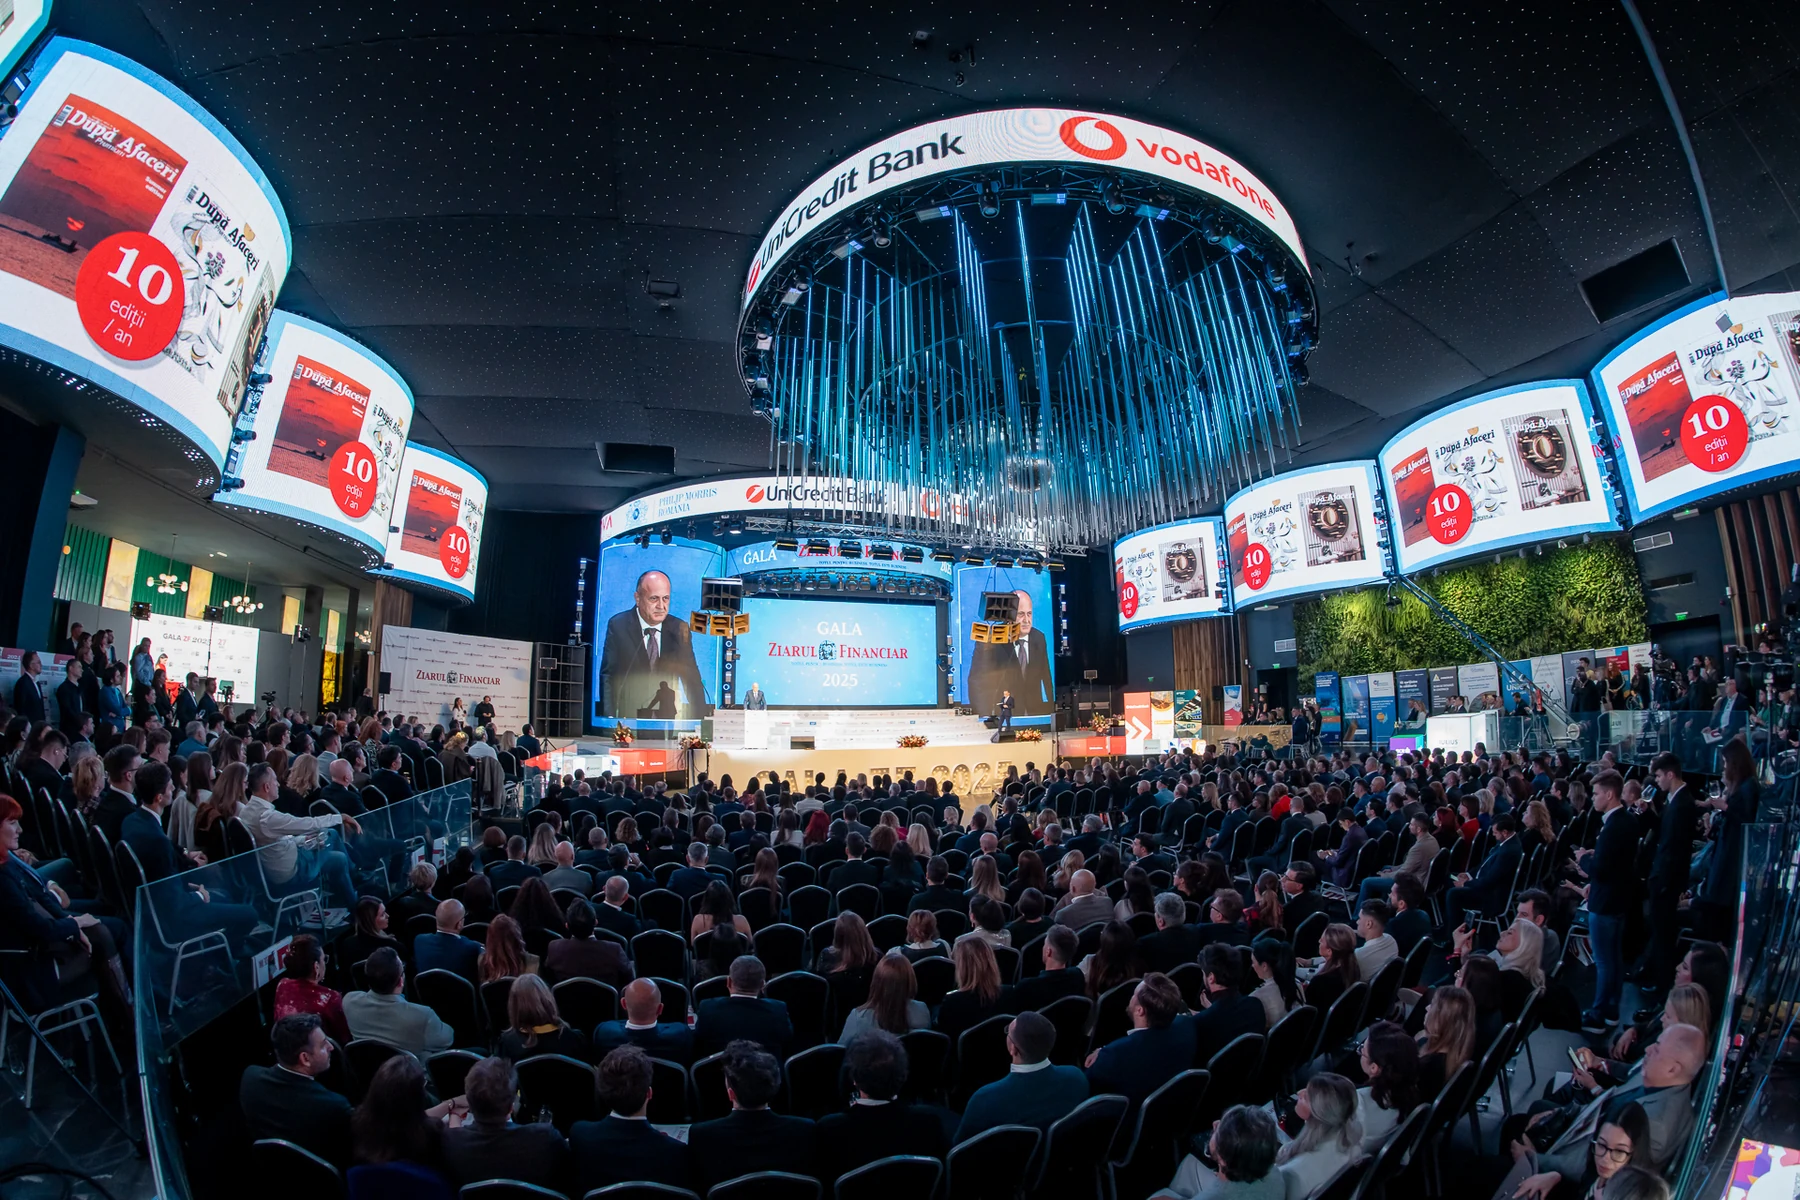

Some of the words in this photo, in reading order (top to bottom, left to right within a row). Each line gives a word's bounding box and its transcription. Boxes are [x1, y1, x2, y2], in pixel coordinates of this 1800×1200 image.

[68, 109, 120, 142] După
[117, 136, 180, 183] Afaceri
[1136, 138, 1276, 220] vodafone
[761, 167, 857, 270] UniCredit
[867, 132, 965, 184] Bank
[195, 191, 231, 231] După
[228, 226, 260, 271] Afaceri
[107, 246, 173, 305] 10
[109, 299, 147, 329] ediții
[114, 328, 133, 347] an
[1695, 344, 1724, 362] După
[1726, 327, 1764, 349] Afaceri
[1647, 359, 1680, 385] Afaceri
[302, 366, 334, 387] După
[333, 381, 368, 407] Afaceri
[1687, 405, 1730, 439] 10
[1439, 440, 1461, 456] După
[1463, 429, 1495, 447] Afaceri
[1716, 451, 1730, 462] an
[342, 451, 373, 483] 10
[438, 485, 462, 500] Afaceri
[658, 494, 685, 507] PHILIP
[685, 487, 718, 502] MORRIS
[767, 484, 842, 502] UniCredit
[350, 499, 359, 510] an
[1431, 491, 1461, 518] 10
[1448, 529, 1458, 537] an
[447, 533, 467, 554] 10
[743, 550, 777, 565] GALA
[1245, 549, 1264, 569] 10
[1122, 587, 1134, 601] 10
[163, 633, 182, 641] GALA
[817, 621, 863, 636] GALA
[768, 642, 818, 657] ZIARUL
[839, 644, 908, 659] FINANCIAR
[416, 669, 447, 682] ZIARUL
[459, 673, 501, 686] FINANCIAR
[822, 673, 858, 687] 2025
